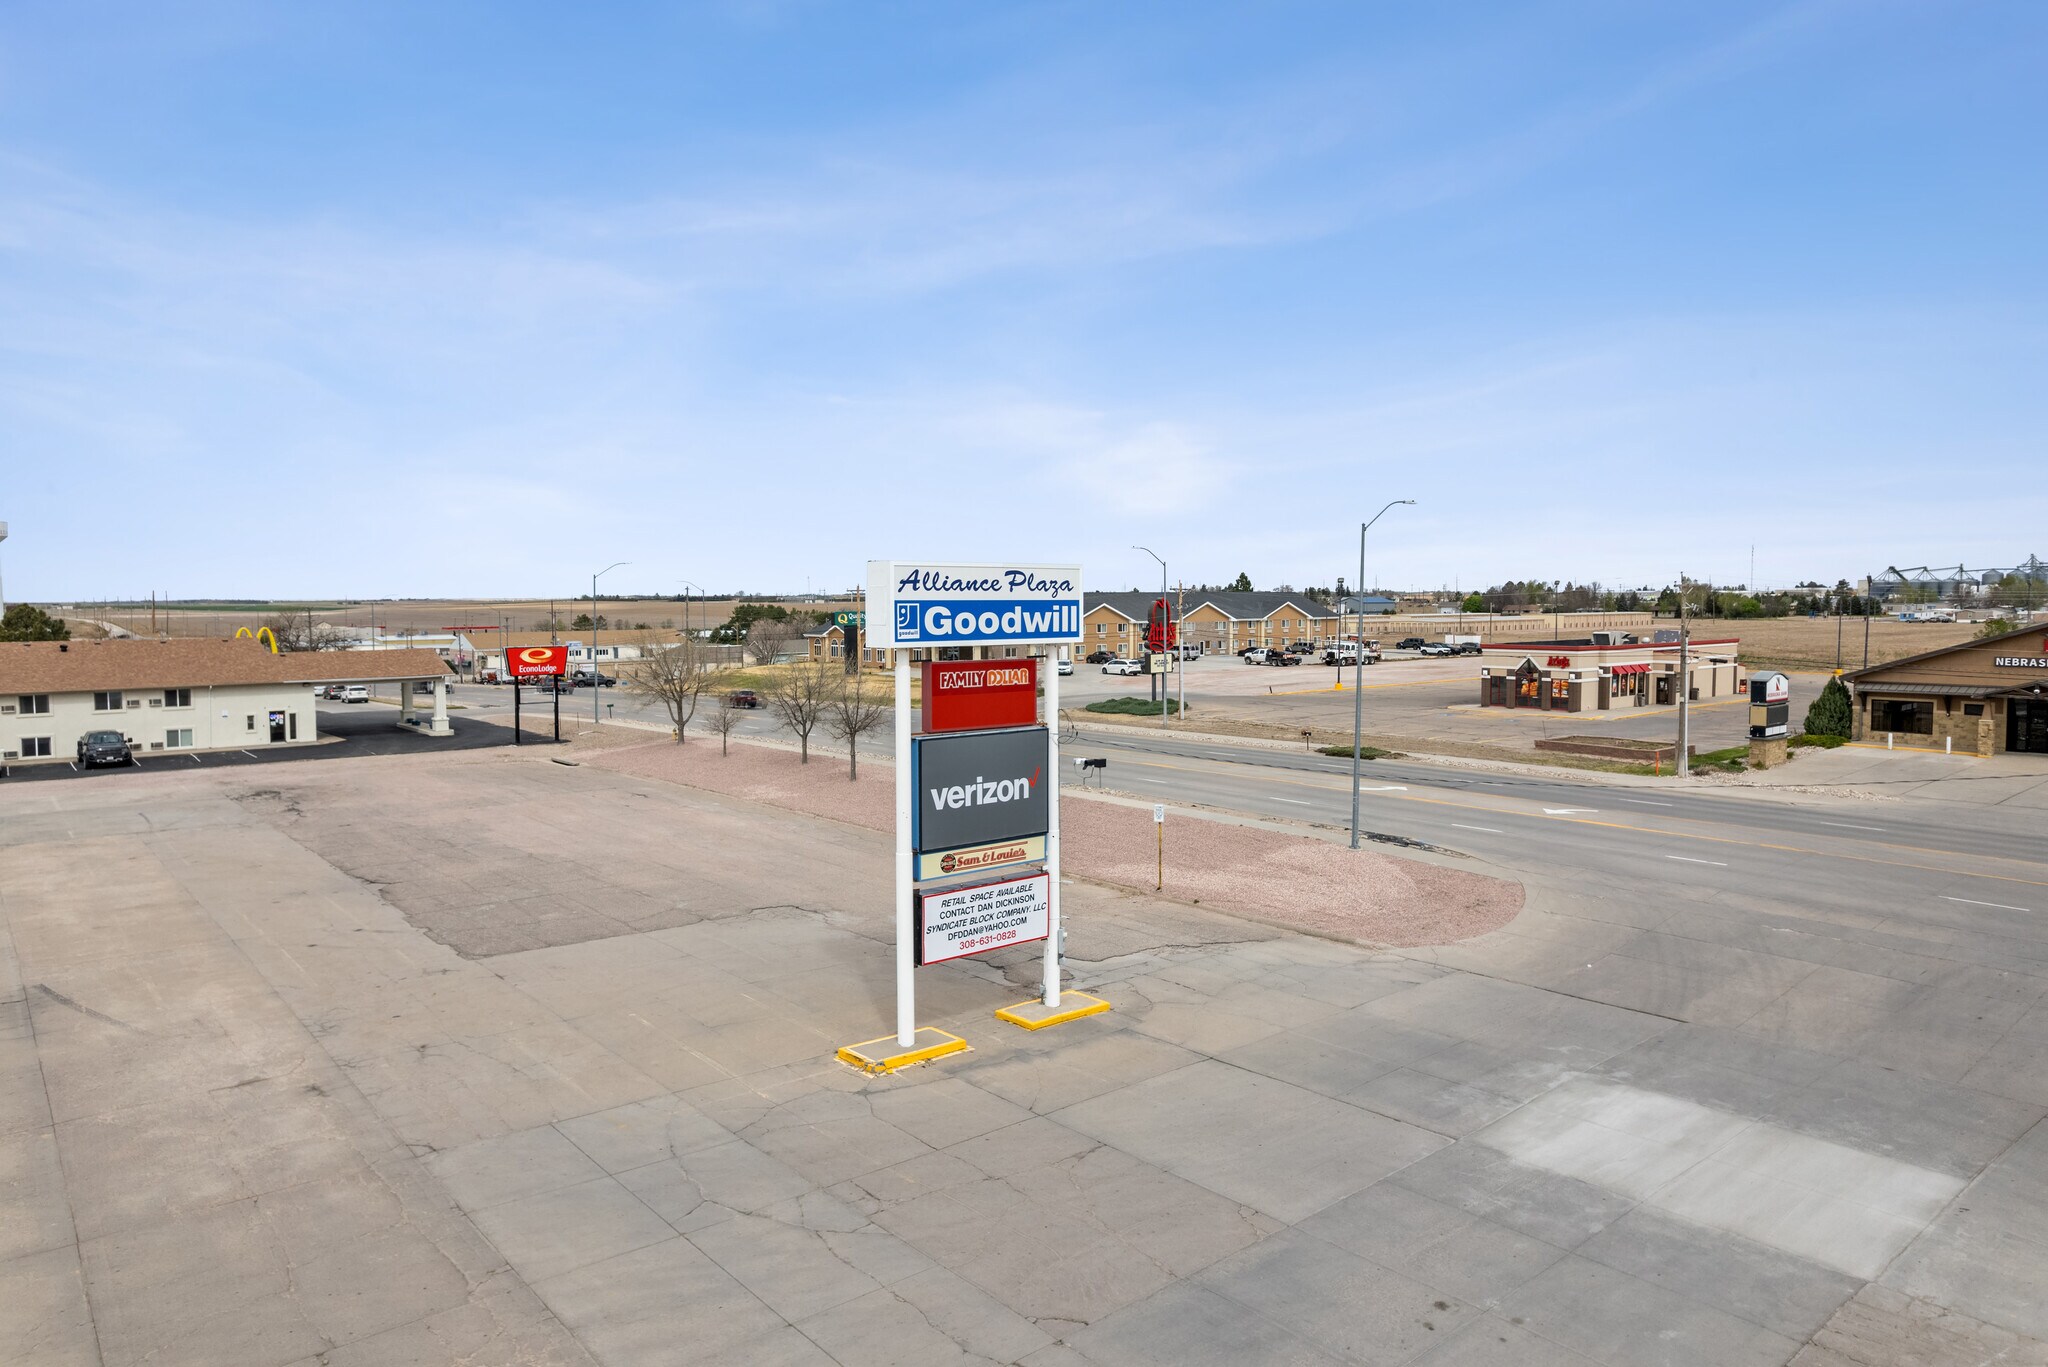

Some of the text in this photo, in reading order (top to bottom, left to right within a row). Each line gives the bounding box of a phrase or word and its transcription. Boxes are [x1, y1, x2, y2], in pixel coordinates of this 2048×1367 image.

[898, 569, 1074, 598] Alliance Plaza
[924, 605, 1077, 636] Goodwill
[1995, 657, 2048, 668] NEBRAS
[940, 668, 1029, 689] FAMILY DOLLAR
[930, 776, 1029, 810] verizon
[956, 855, 981, 867] Sam
[981, 852, 991, 862] &
[990, 848, 1026, 861] Louie's
[939, 894, 1035, 920] CONTACT DAN DICKINSON
[941, 883, 1033, 908] RETAIL SPACE AVAILABLE
[926, 918, 968, 934] SYNDICATE
[969, 913, 994, 926] BLOCK
[1033, 902, 1047, 912] LLC
[947, 916, 1028, 941] DFDDAN@YAHOO.COM
[959, 929, 1017, 950] 308-631-0828
